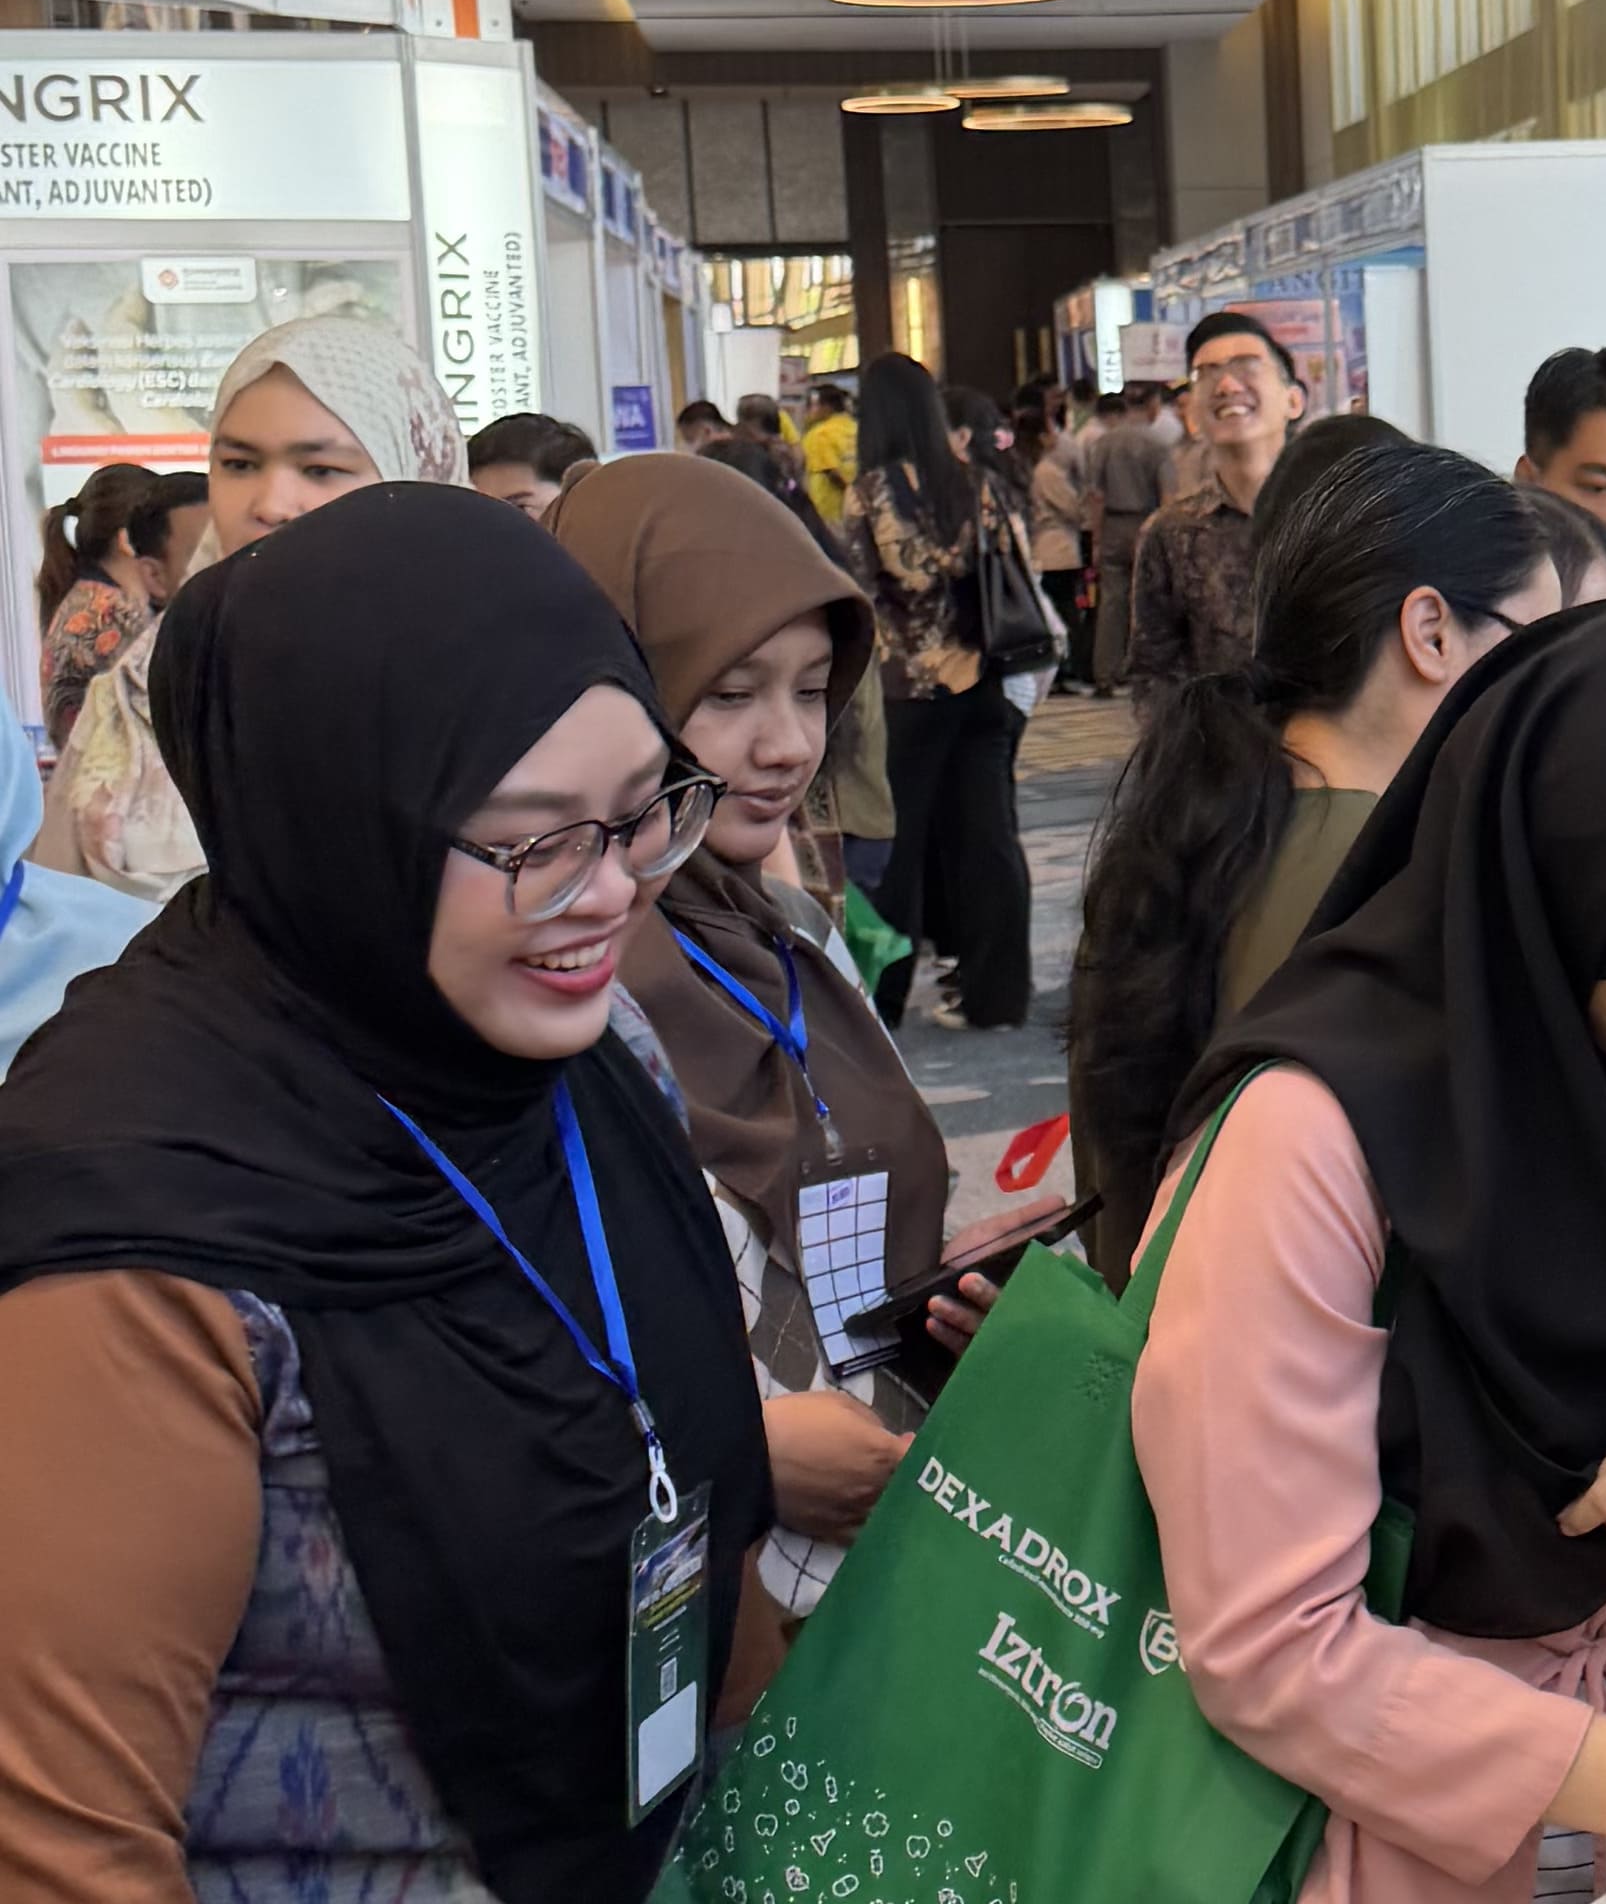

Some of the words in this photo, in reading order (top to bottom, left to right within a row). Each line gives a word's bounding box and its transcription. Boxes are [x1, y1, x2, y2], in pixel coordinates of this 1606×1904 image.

[1, 143, 57, 168] STER
[63, 142, 162, 168] VACCINE
[48, 177, 213, 207] ADJUVANTED)
[483, 269, 505, 346] VACCINE
[504, 231, 529, 361] ADJUVANTED)
[139, 370, 186, 390] (ESC)
[490, 352, 508, 418] OSTER
[917, 1456, 1122, 1625] DEXADROX
[978, 1611, 1118, 1750] Iztron
